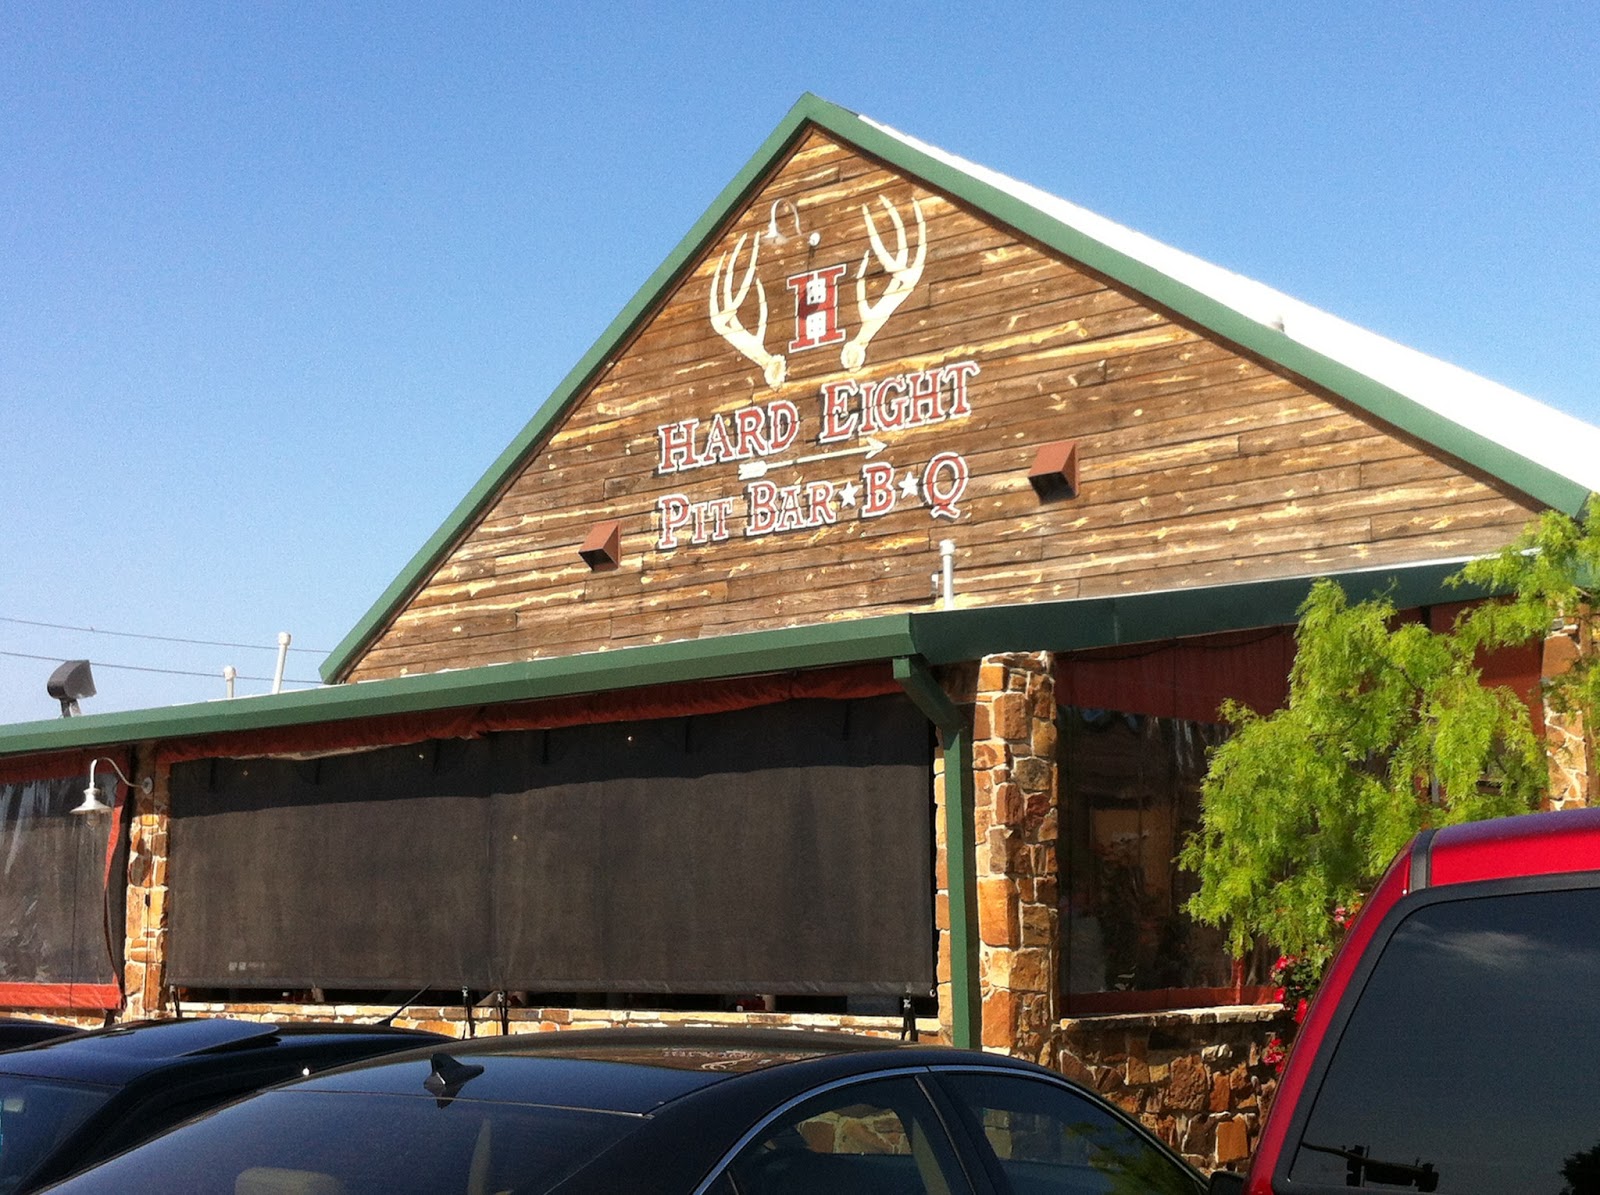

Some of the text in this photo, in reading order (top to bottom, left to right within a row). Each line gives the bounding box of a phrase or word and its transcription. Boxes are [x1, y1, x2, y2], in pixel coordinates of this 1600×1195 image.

[787, 264, 846, 353] H
[658, 361, 979, 474] HARD EIGHT
[659, 494, 733, 549] PIT
